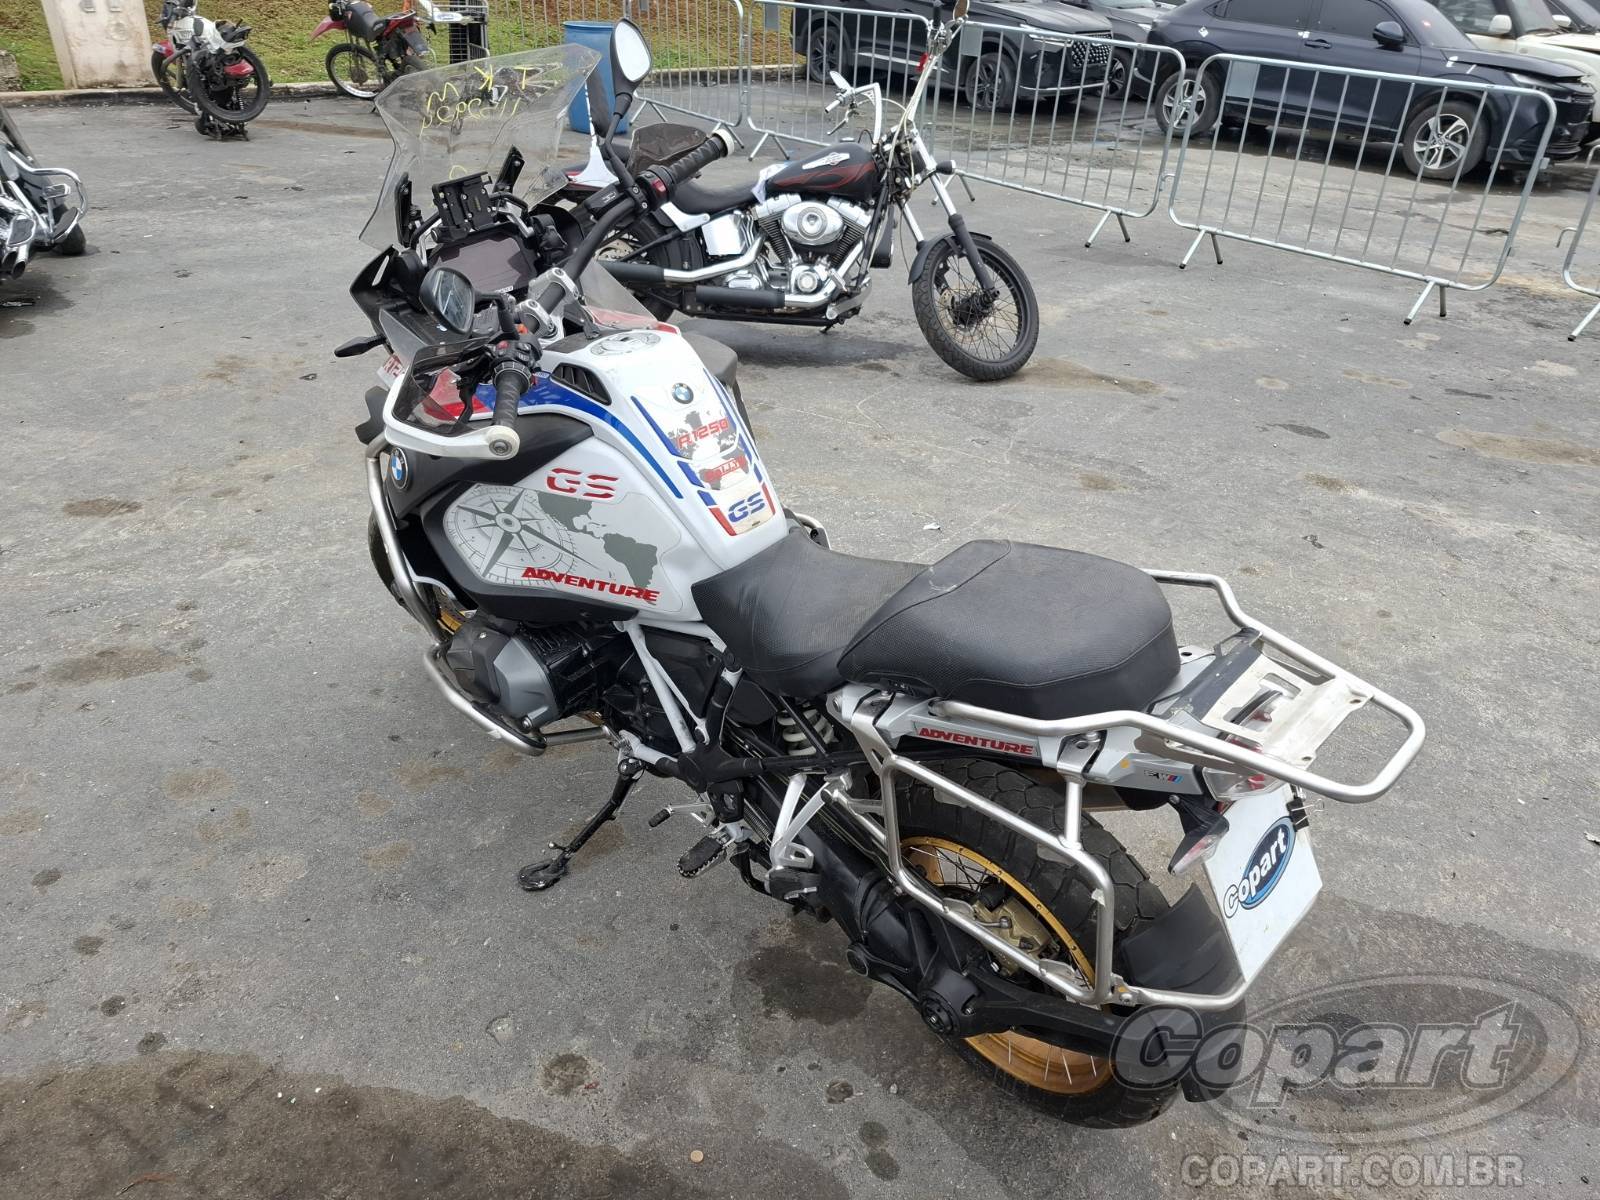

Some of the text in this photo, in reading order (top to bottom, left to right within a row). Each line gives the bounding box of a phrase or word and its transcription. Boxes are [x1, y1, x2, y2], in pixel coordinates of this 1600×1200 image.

[546, 467, 618, 499] GS
[728, 491, 766, 523] GS
[521, 566, 660, 603] ADVENTURE
[918, 727, 1034, 755] ADVENTURE
[1222, 826, 1289, 919] Copart
